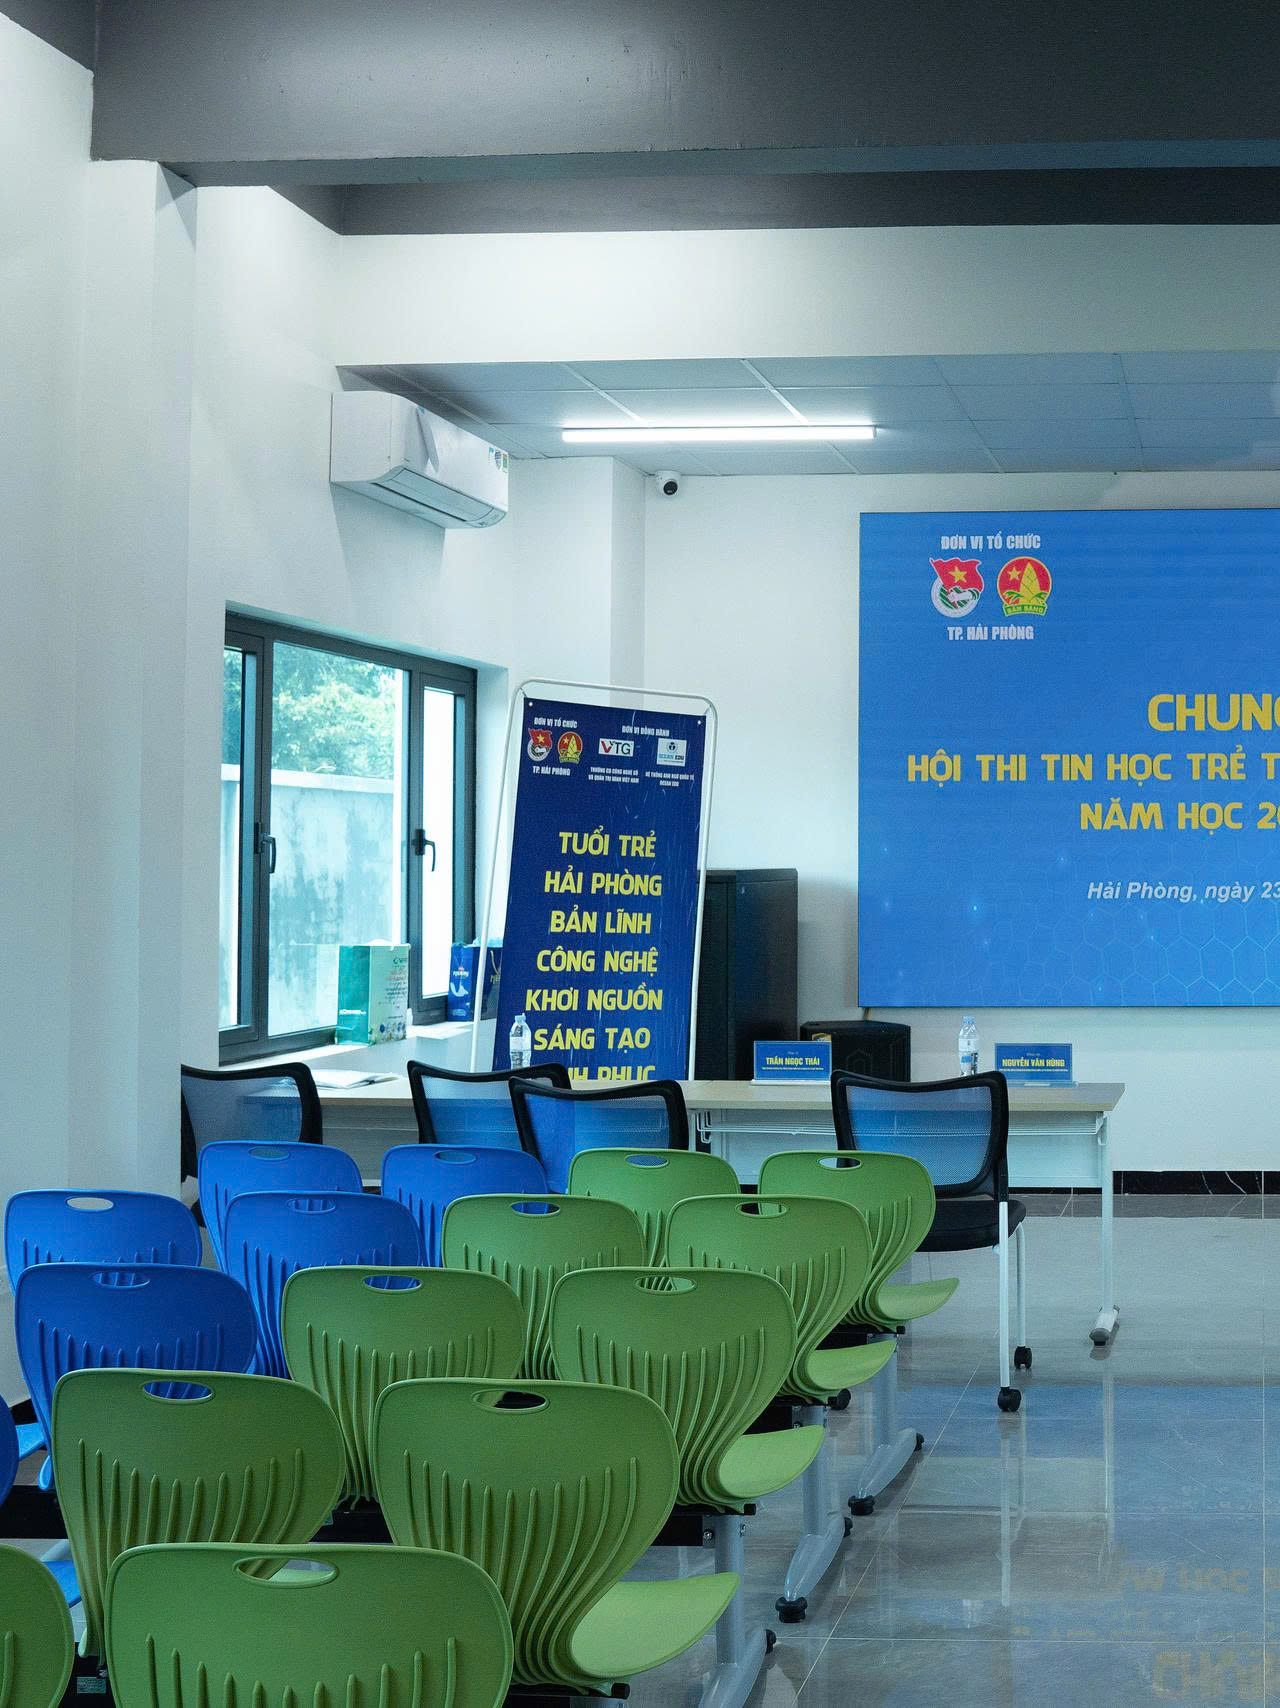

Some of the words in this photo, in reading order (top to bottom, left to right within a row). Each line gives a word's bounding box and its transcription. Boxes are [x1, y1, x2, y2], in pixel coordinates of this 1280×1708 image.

[941, 534, 967, 549] ĐƠN
[970, 535, 983, 551] VỊ
[987, 530, 1002, 549] TỔ
[1007, 533, 1041, 549] CHỨC
[947, 627, 963, 640] TP.
[967, 623, 988, 640] HẢI
[992, 623, 1034, 640] PHÒNG
[601, 740, 631, 755] VTG
[907, 748, 961, 787] HỘI
[975, 754, 1027, 782] THI
[1041, 753, 1093, 781] TIN
[1106, 753, 1173, 787] HỌC
[1187, 744, 1246, 780] TRẺ
[1080, 797, 1164, 830] NĂM
[1178, 801, 1243, 836] HỌC
[559, 825, 610, 856] TUỔI
[618, 831, 657, 858] TRẺ
[544, 864, 583, 894] HẢI
[591, 869, 662, 896] PHÒNG
[1087, 881, 1121, 900] Hải
[1126, 881, 1197, 903] Phòng,
[1205, 881, 1256, 903] ngày
[549, 904, 598, 933] BẢN
[605, 908, 652, 934] LĨNH
[536, 946, 596, 972] CÔNG
[603, 947, 659, 977] NGHỆ
[525, 987, 579, 1011] KHƠI
[587, 981, 663, 1011] NGUỒN
[533, 1024, 595, 1050] SÁNG
[605, 1027, 651, 1054] TẠO
